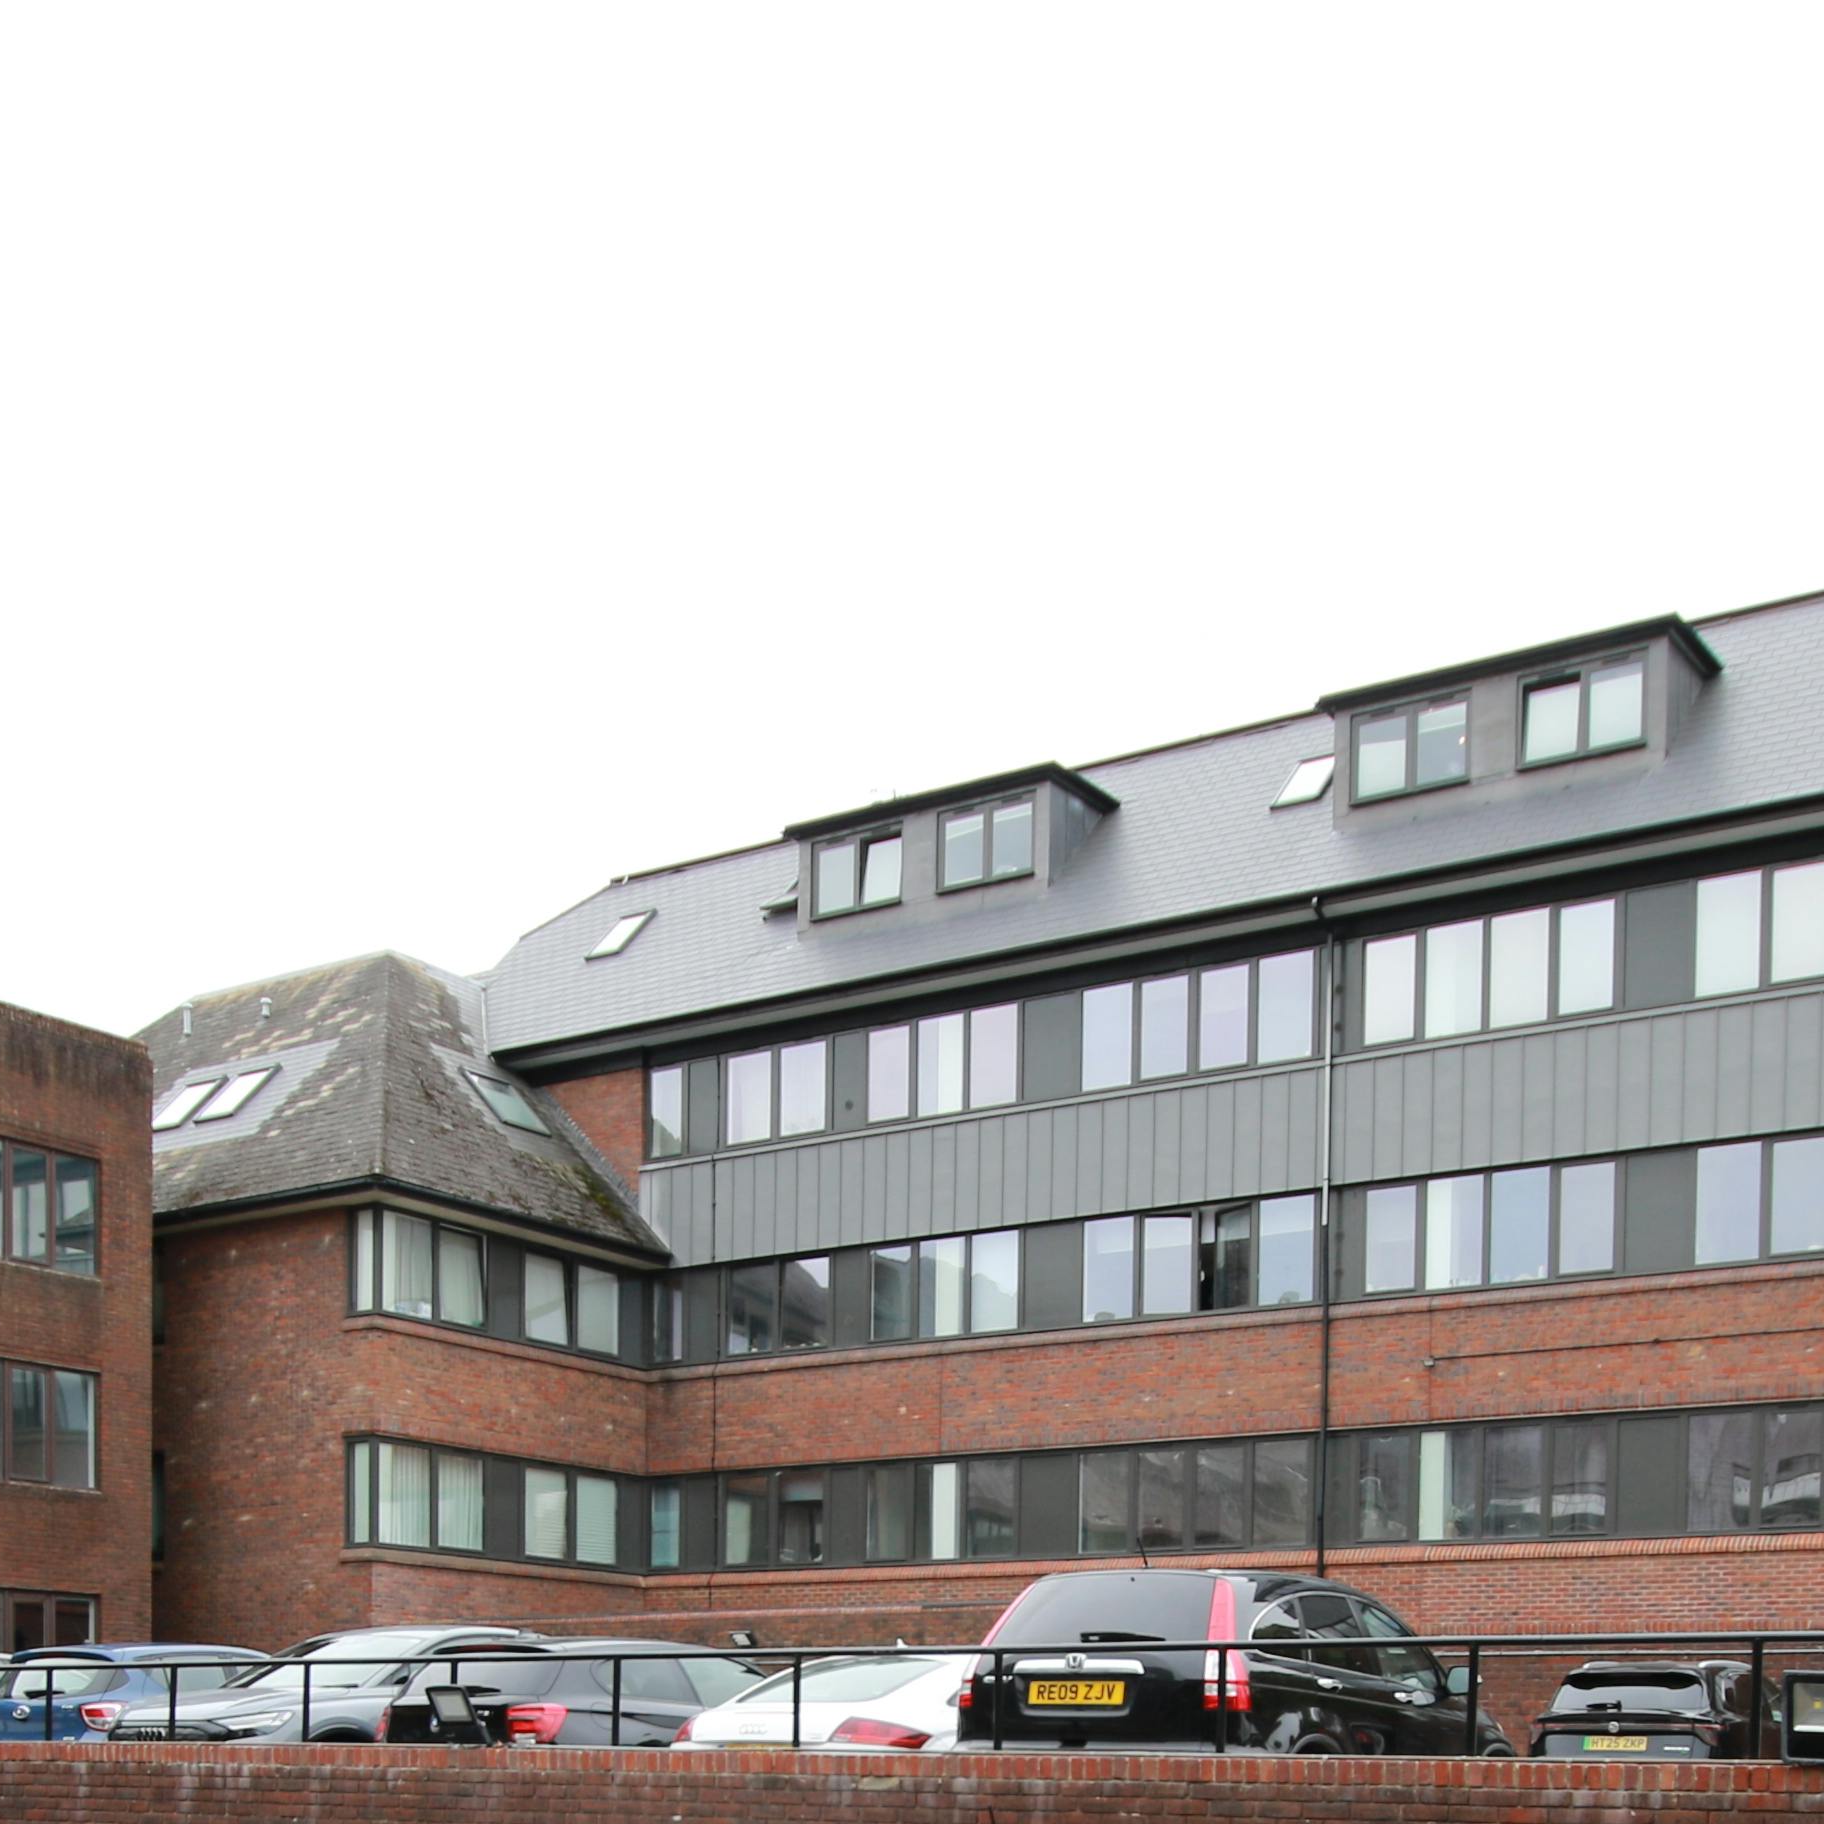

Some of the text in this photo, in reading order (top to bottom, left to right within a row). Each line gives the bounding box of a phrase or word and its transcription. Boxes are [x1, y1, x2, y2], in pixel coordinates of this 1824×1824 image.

[1036, 1684, 1116, 1701] RE09 ZJV
[1591, 1737, 1622, 1748] HT25
